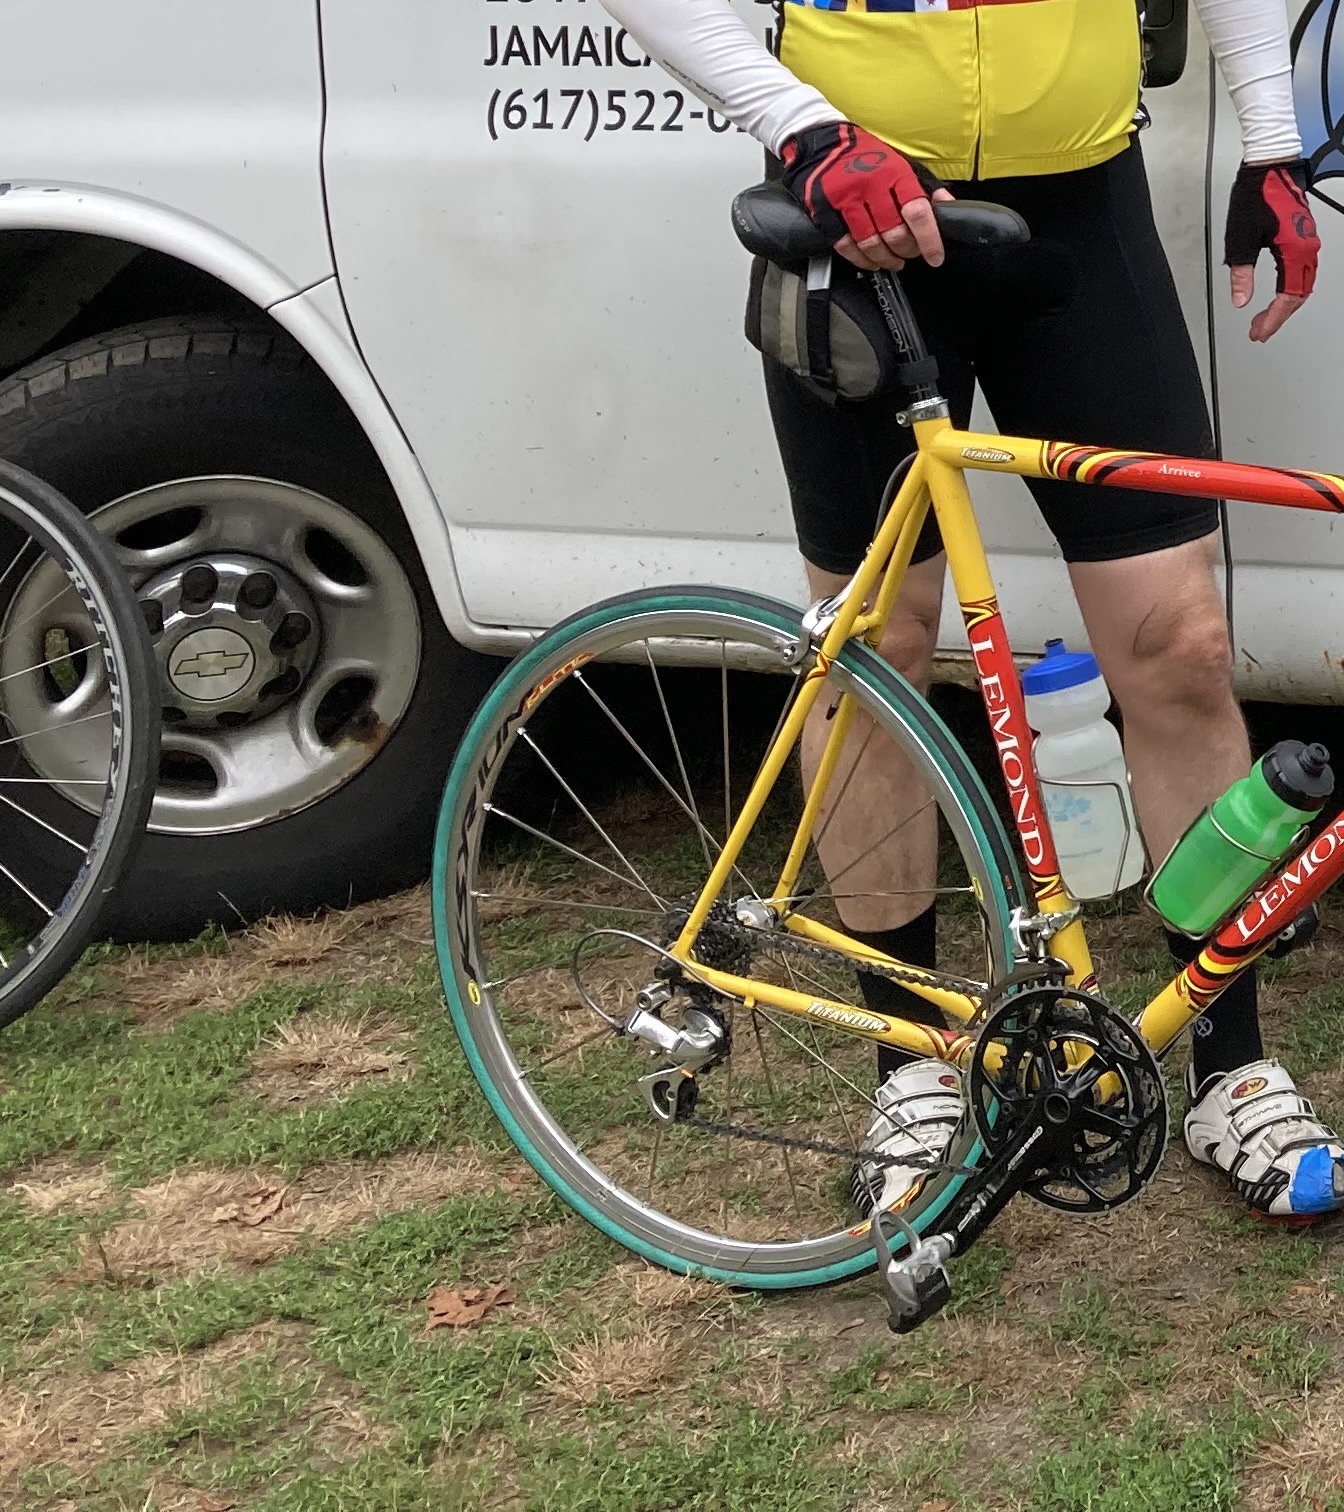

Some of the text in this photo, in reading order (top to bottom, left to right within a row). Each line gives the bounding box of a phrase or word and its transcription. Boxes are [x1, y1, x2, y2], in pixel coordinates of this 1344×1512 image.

[484, 25, 653, 67] JAMAIC
[871, 274, 907, 354] THOMSON
[960, 447, 1012, 463] TITANIUM
[65, 557, 122, 794] RITCHEY
[970, 634, 1044, 867] LEMOND
[806, 1001, 887, 1032] TITANIUM
